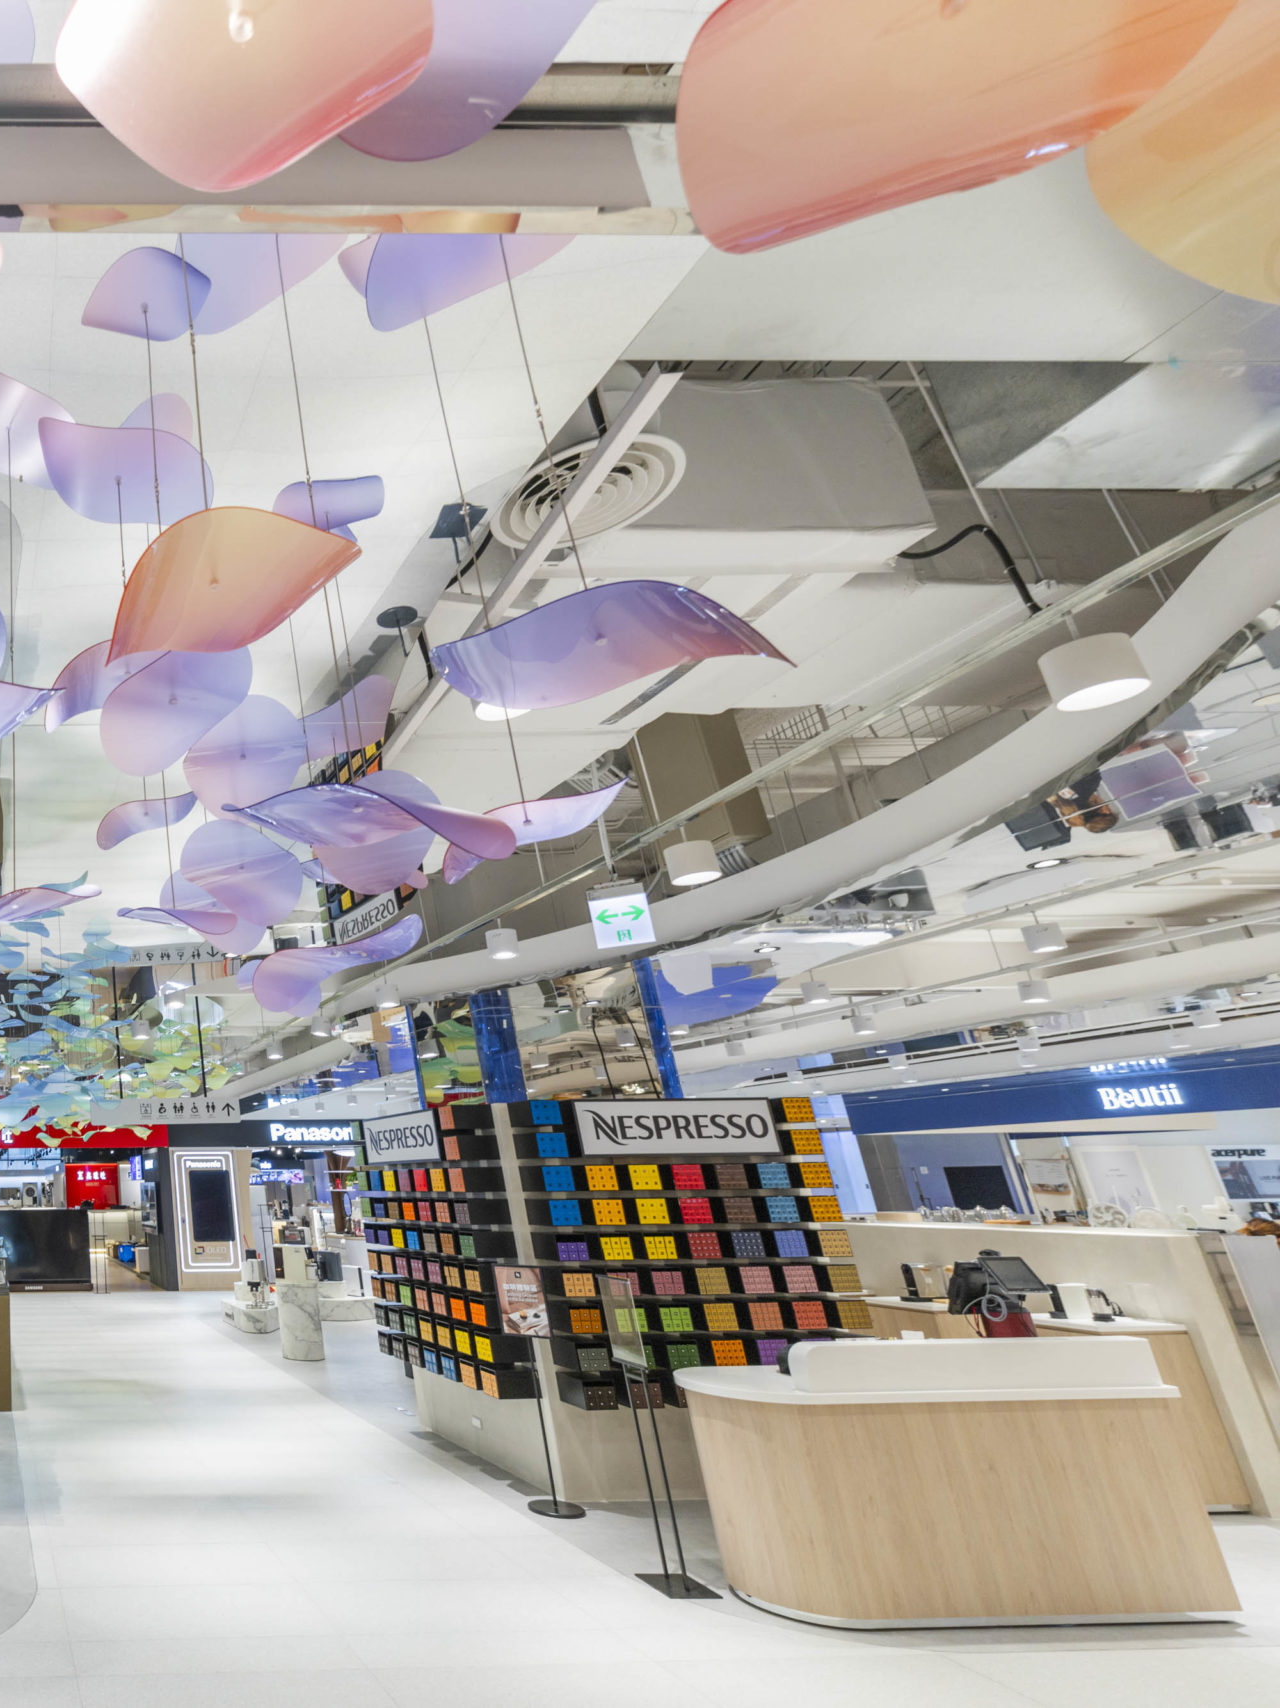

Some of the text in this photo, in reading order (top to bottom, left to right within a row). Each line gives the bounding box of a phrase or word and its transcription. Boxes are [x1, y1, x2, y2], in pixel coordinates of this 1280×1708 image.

[270, 1123, 353, 1142] Panason
[583, 1109, 769, 1146] NESPRESSO
[367, 1124, 434, 1156] NESPRESSO
[1211, 1148, 1266, 1159] acerpure
[186, 1161, 221, 1169] Panasonic
